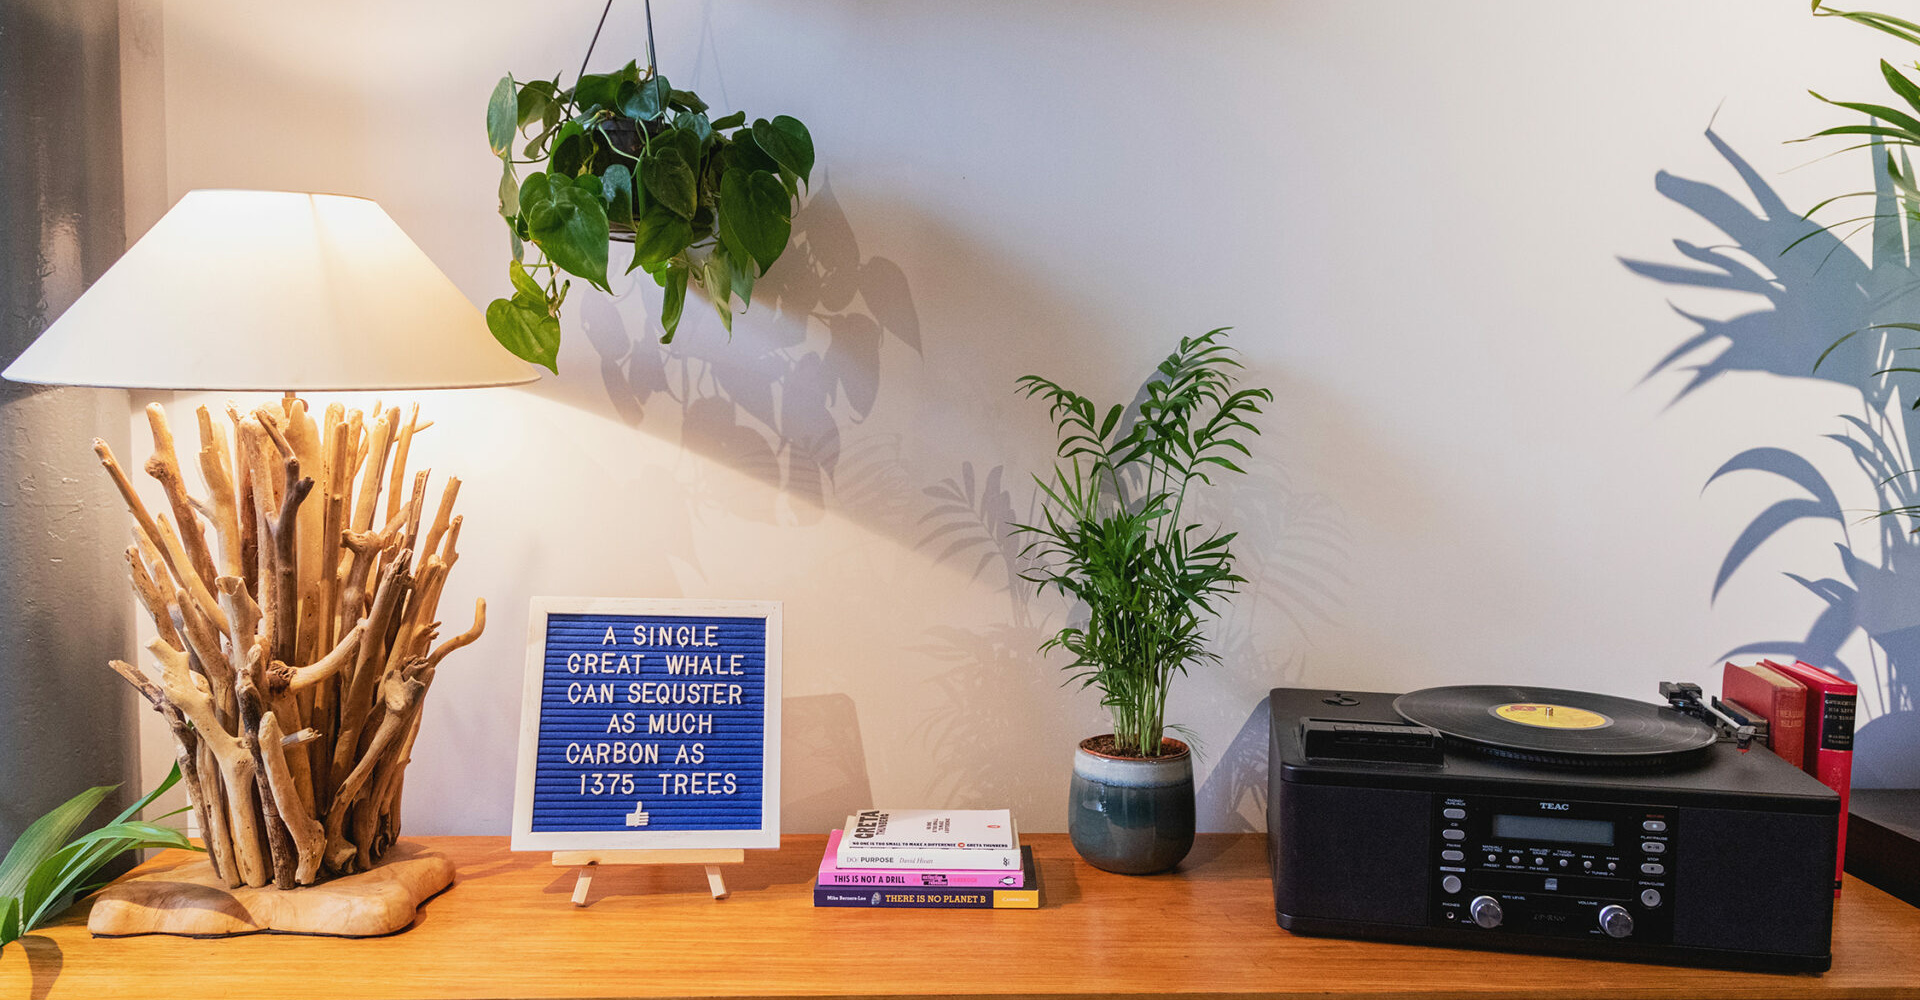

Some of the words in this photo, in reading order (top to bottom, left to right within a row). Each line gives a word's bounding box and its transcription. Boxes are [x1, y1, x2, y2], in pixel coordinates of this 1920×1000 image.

[602, 626, 617, 646] A
[632, 625, 719, 648] SINGLE
[567, 653, 645, 675] GREAT
[665, 654, 744, 676] WHALE
[567, 683, 614, 704] CAN
[627, 683, 743, 704] SEQUSTER
[606, 712, 636, 734] AS
[648, 712, 713, 734] MUCH
[566, 742, 659, 764] CARBON
[675, 743, 705, 764] AS
[580, 774, 635, 795] 1375
[658, 773, 737, 795] TREES
[1540, 802, 1570, 811] TEAC
[854, 810, 880, 839] GRETA
[885, 894, 914, 903] THERE
